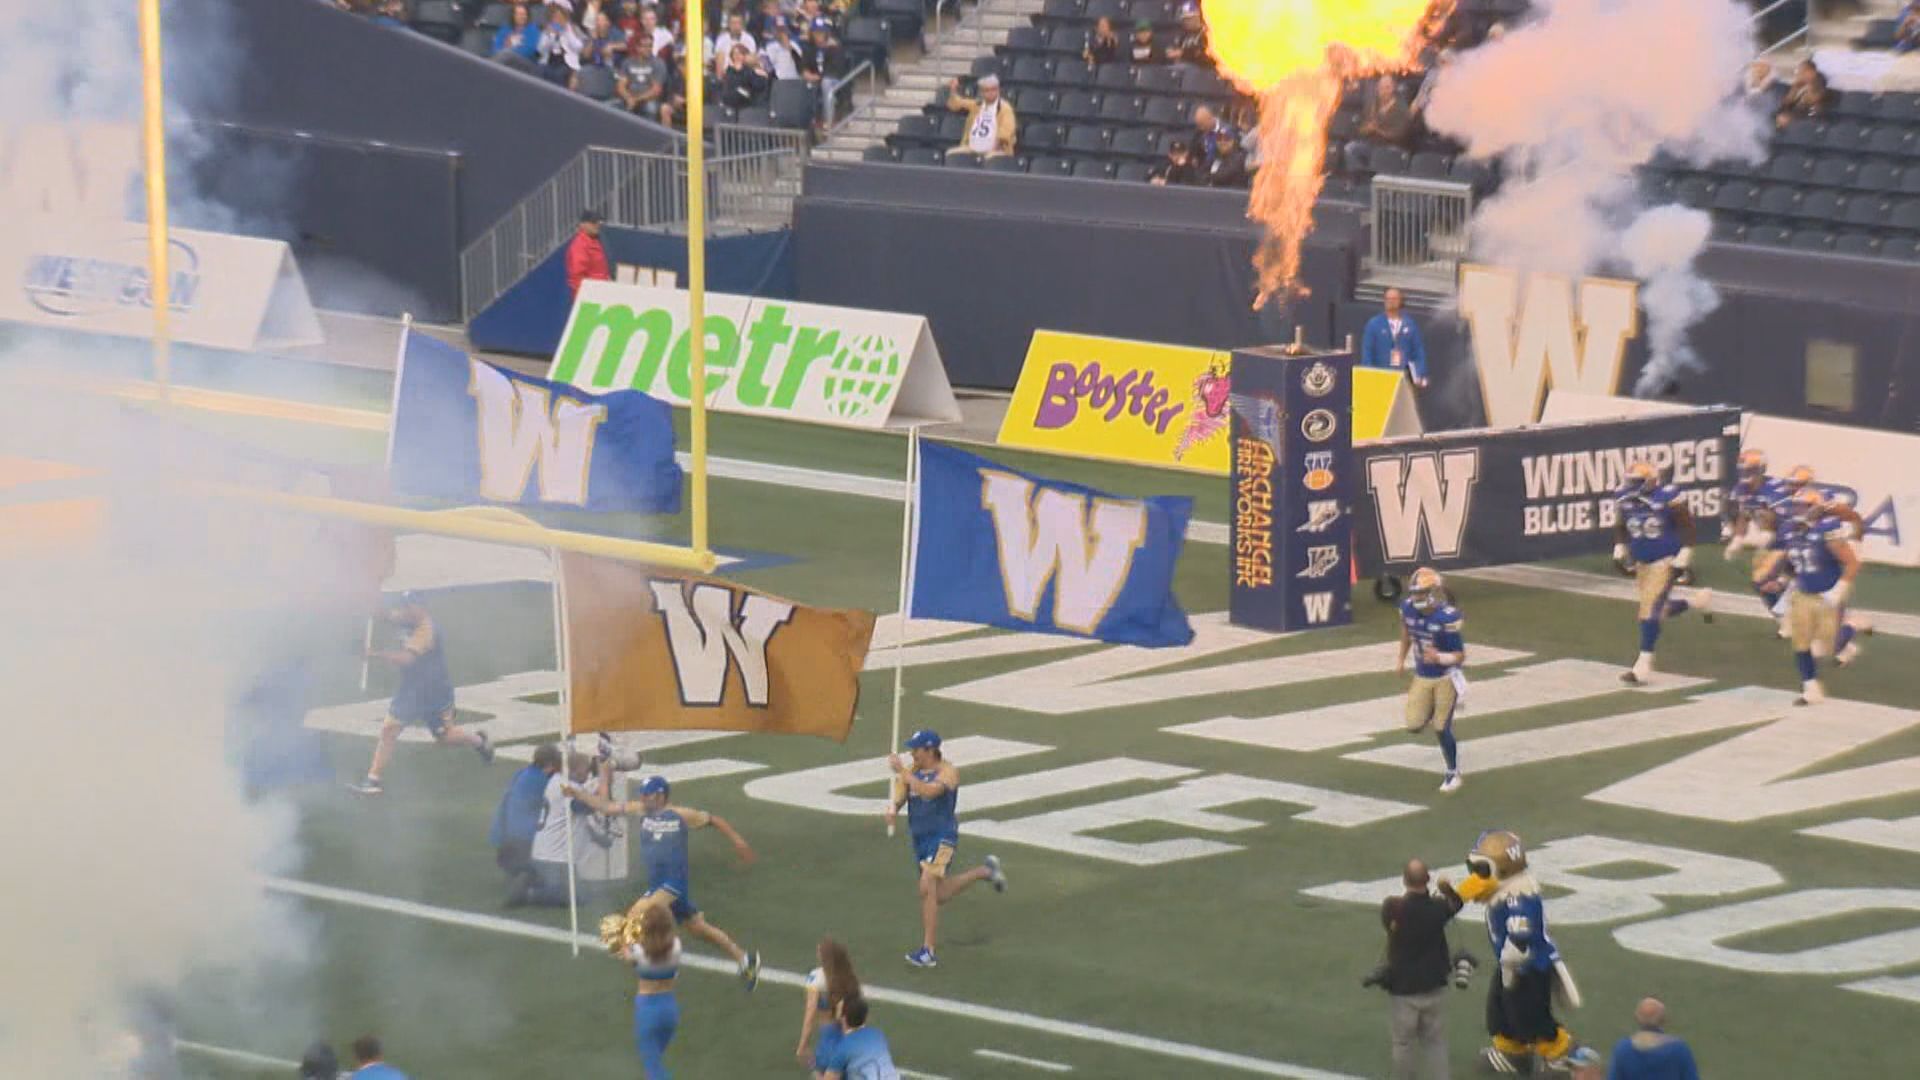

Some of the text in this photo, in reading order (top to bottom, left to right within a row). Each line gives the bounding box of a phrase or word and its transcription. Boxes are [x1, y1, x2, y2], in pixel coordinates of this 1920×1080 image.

[1034, 361, 1184, 434] Booster
[1458, 263, 1640, 428] W
[467, 356, 608, 507] W
[976, 467, 1148, 635] W
[1251, 438, 1274, 588] ARCHANGEL
[1366, 447, 1480, 563] W
[1524, 493, 1591, 537] BLUE
[647, 576, 798, 710] W
[1303, 591, 1333, 625] W
